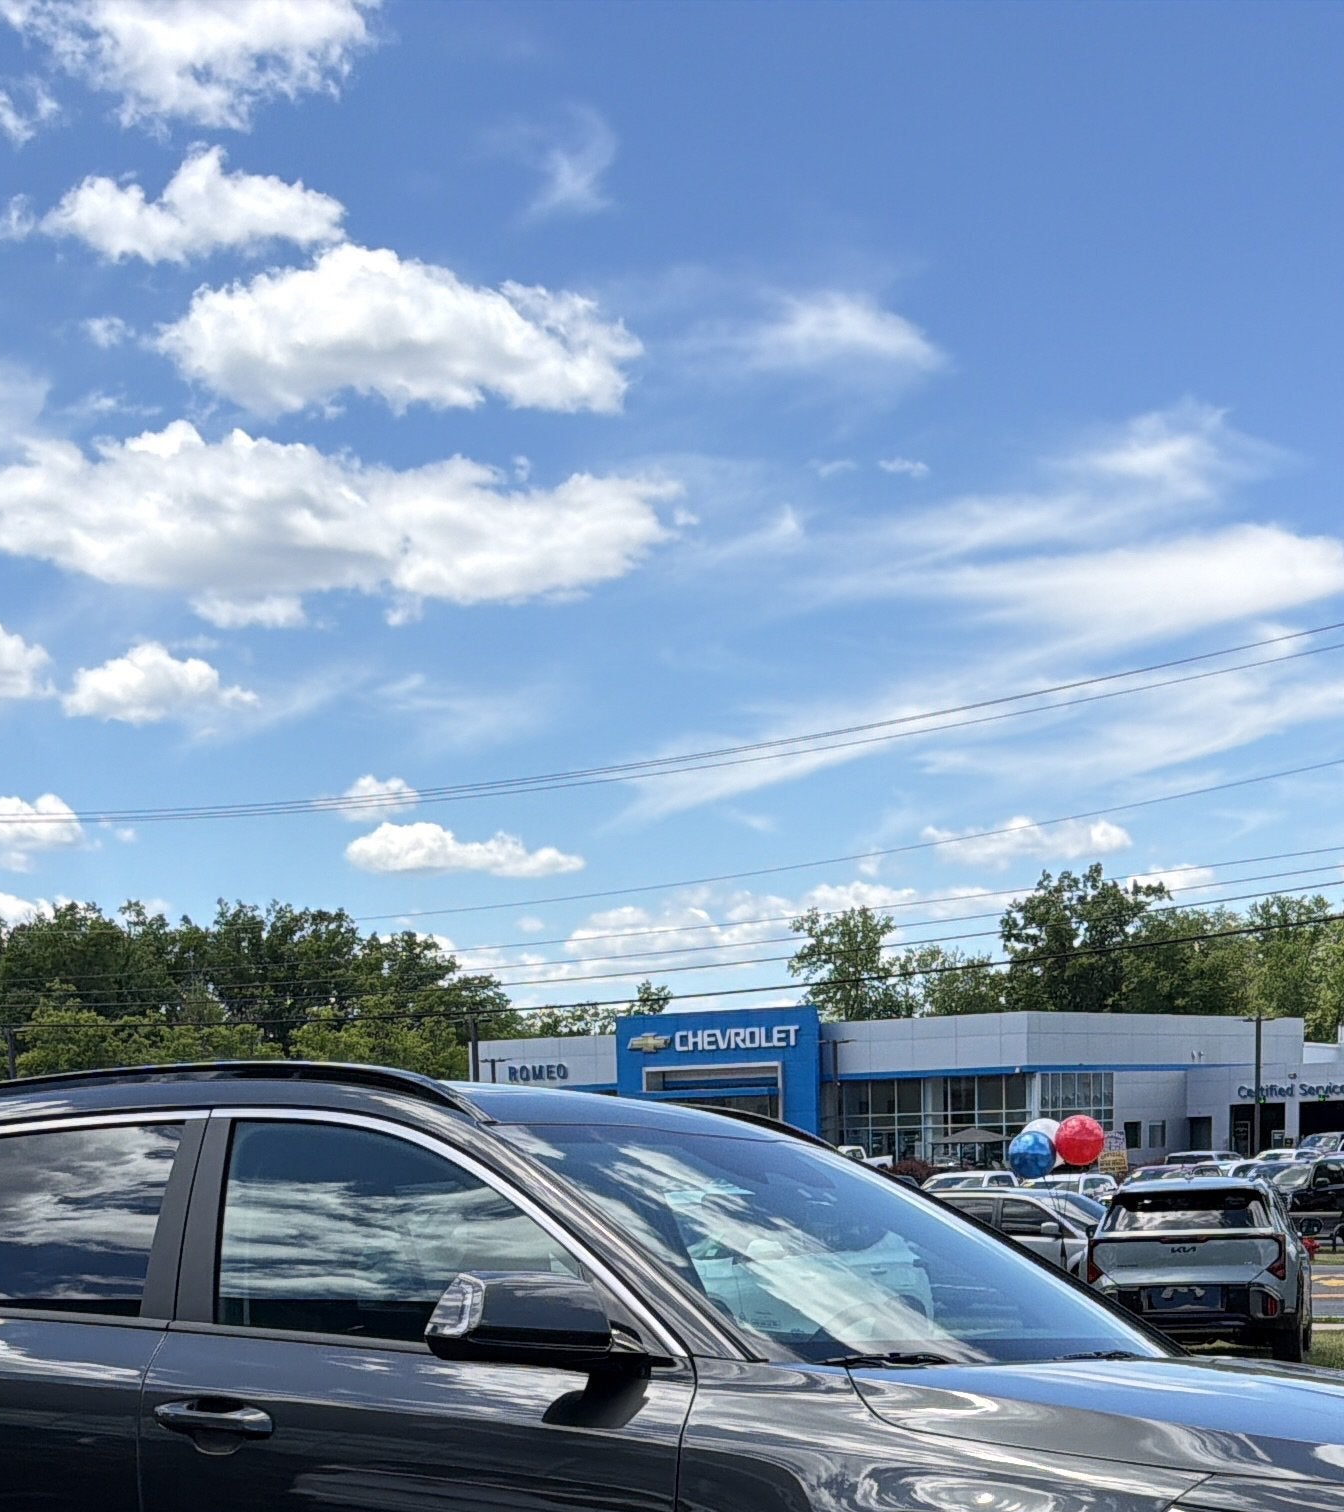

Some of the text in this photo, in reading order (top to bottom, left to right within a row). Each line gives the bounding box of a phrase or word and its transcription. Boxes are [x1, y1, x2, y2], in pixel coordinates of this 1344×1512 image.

[675, 1025, 800, 1052] CHEVROLET
[508, 1063, 569, 1082] ROMEO
[1238, 1084, 1295, 1099] Cetified
